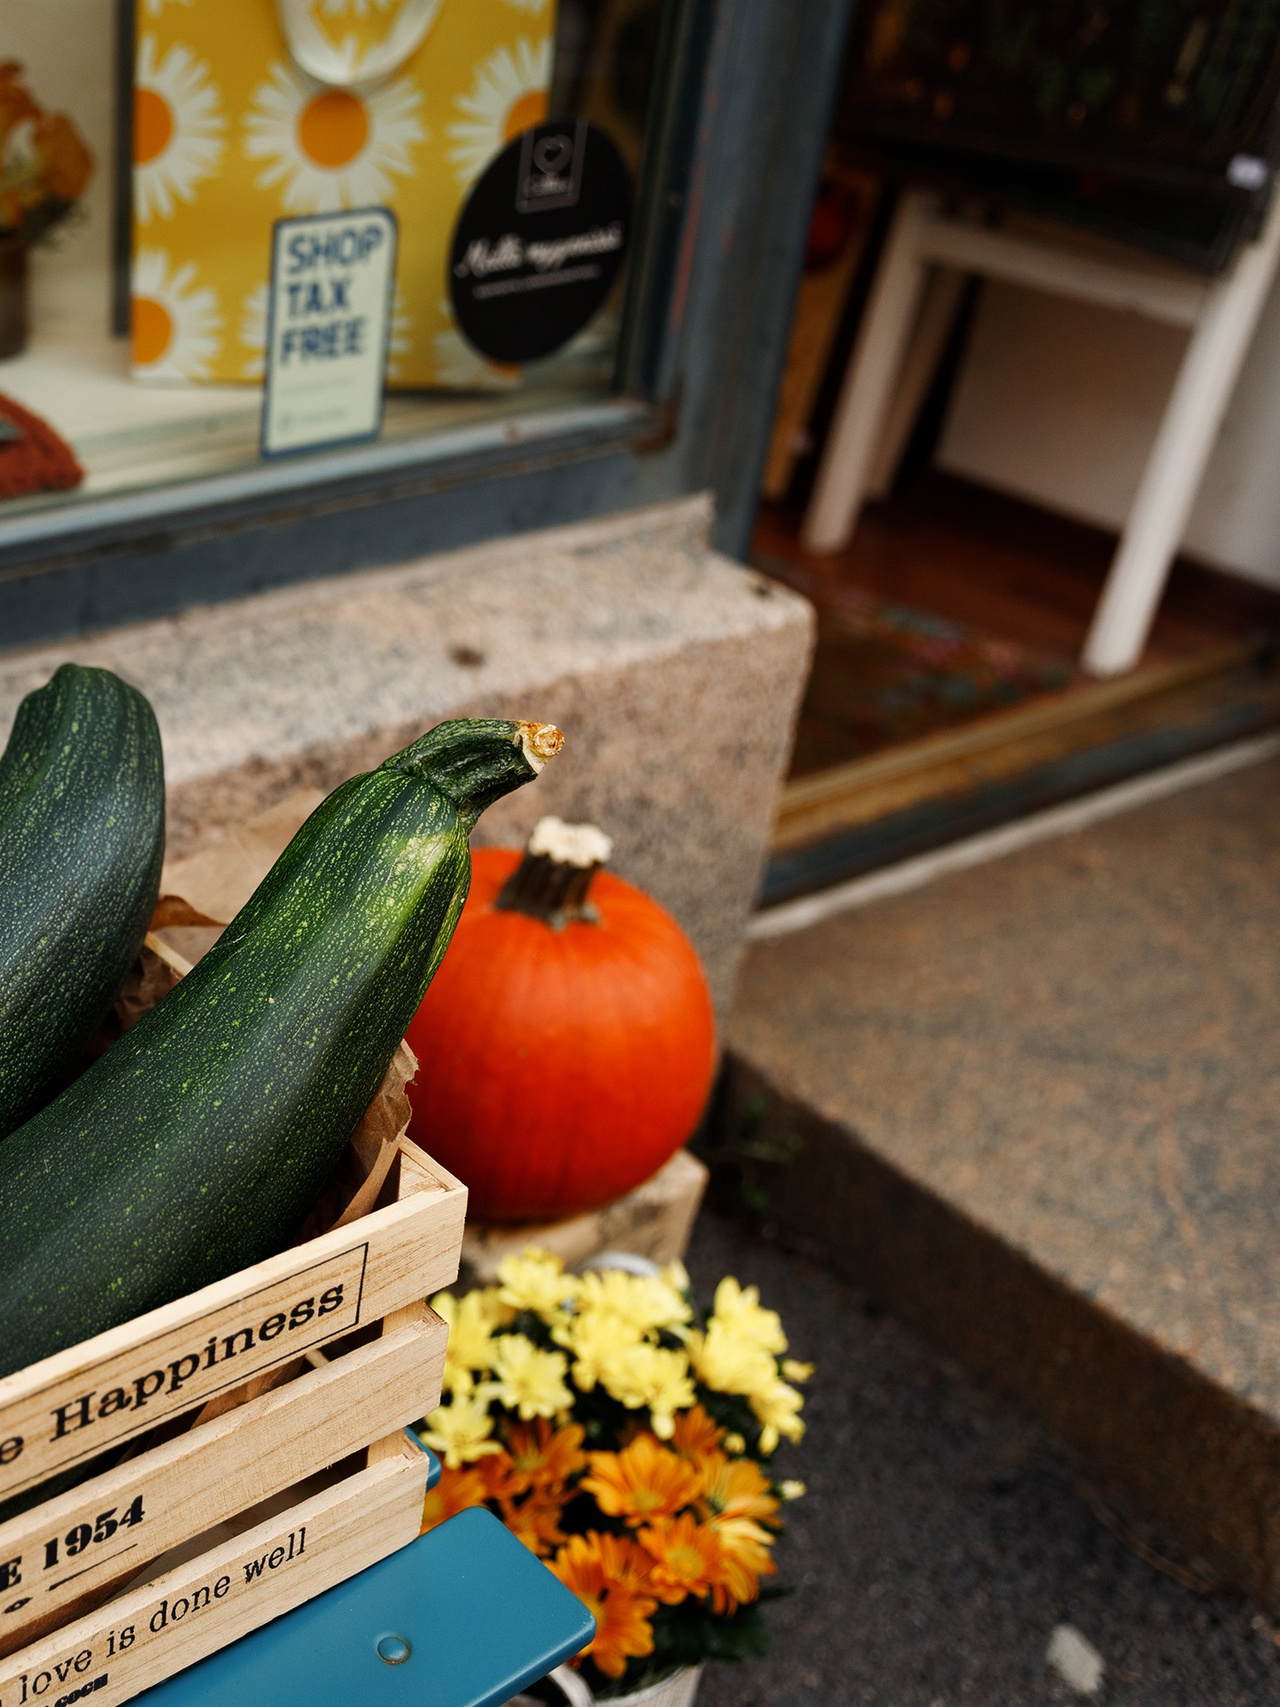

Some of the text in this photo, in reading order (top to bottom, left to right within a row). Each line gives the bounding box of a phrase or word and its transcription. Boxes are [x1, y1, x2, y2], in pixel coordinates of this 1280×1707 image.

[286, 224, 384, 276] SHOP
[287, 277, 353, 318] TAX
[279, 316, 368, 370] FREE
[48, 1283, 345, 1443] Happiness
[42, 1494, 146, 1571] 1954
[18, 1526, 307, 1705] love is done well
